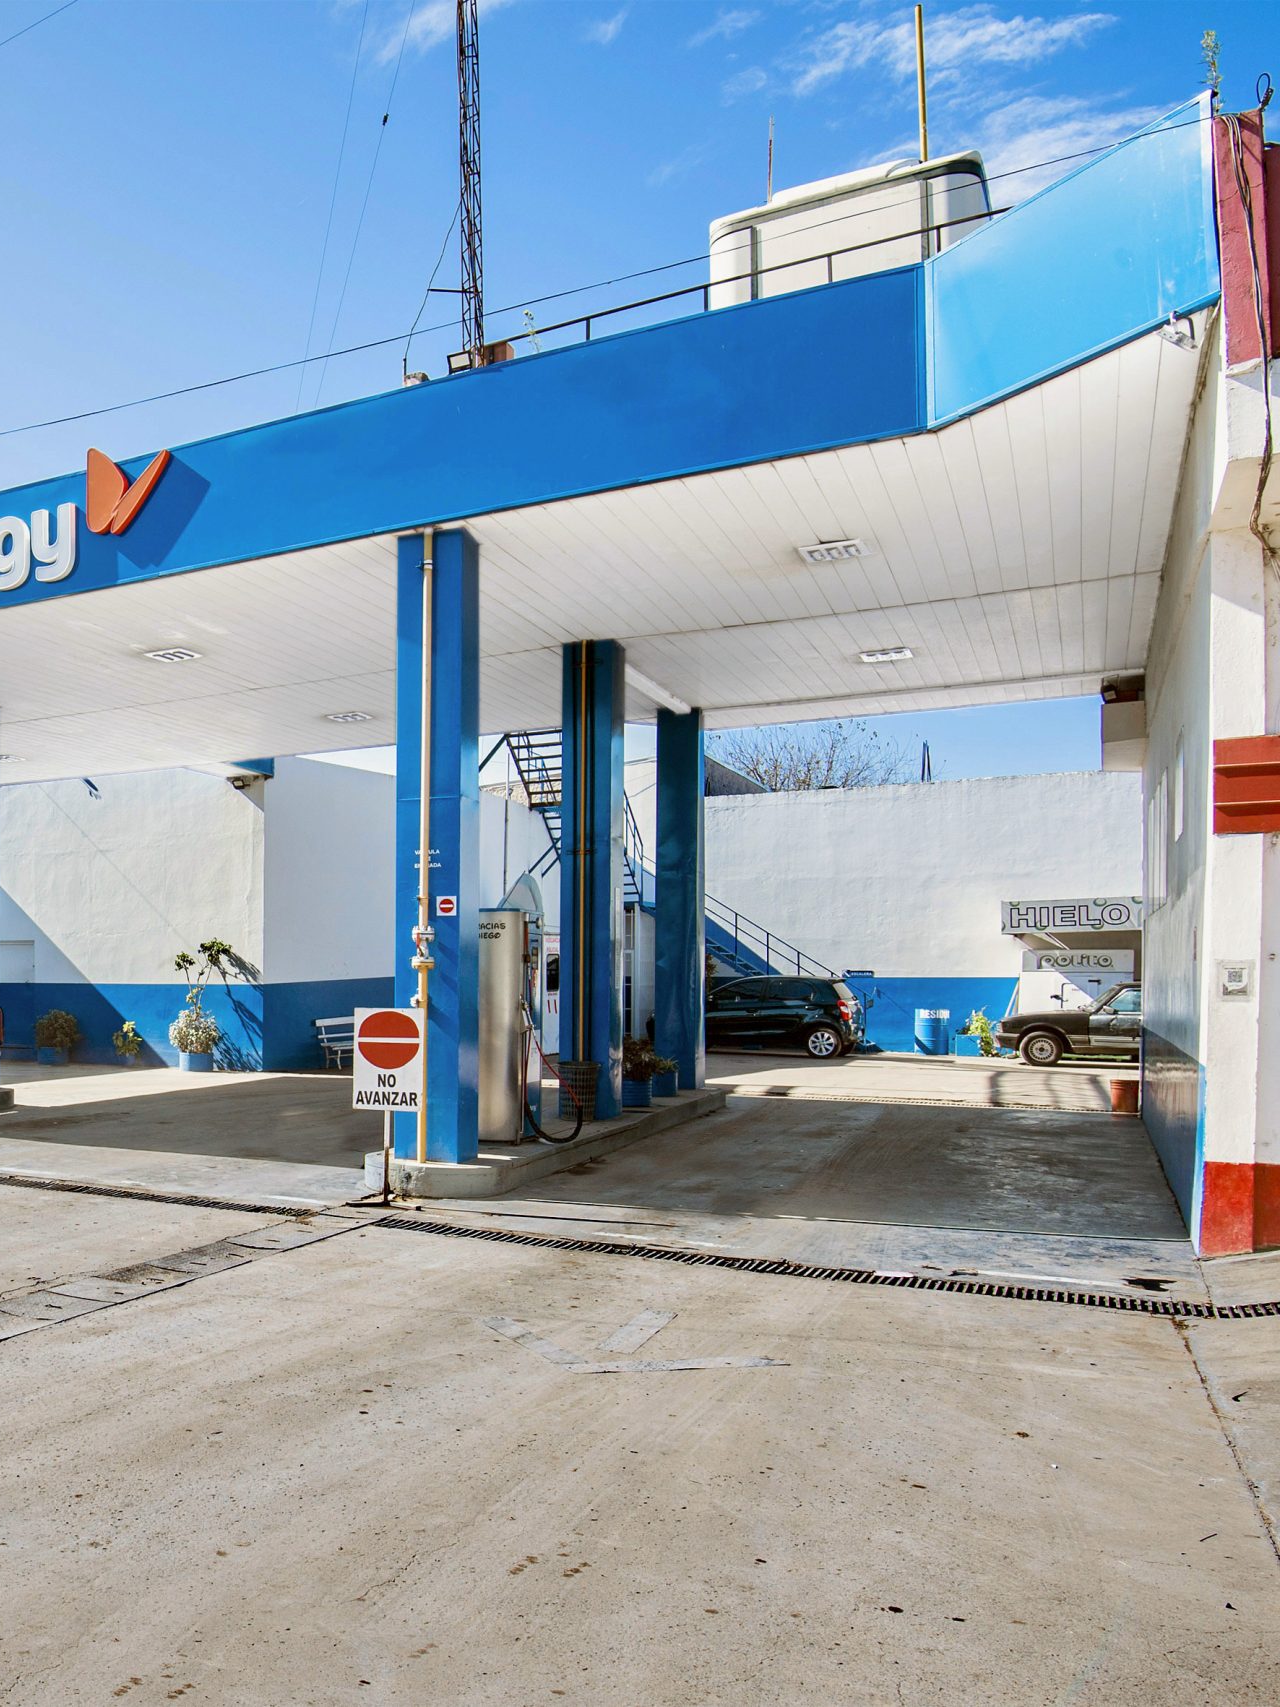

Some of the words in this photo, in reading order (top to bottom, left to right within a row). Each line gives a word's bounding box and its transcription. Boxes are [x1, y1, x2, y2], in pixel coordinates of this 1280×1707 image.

[1009, 903, 1131, 928] HIELO
[377, 1073, 397, 1088] NO
[355, 1091, 418, 1107] AVANZAR
